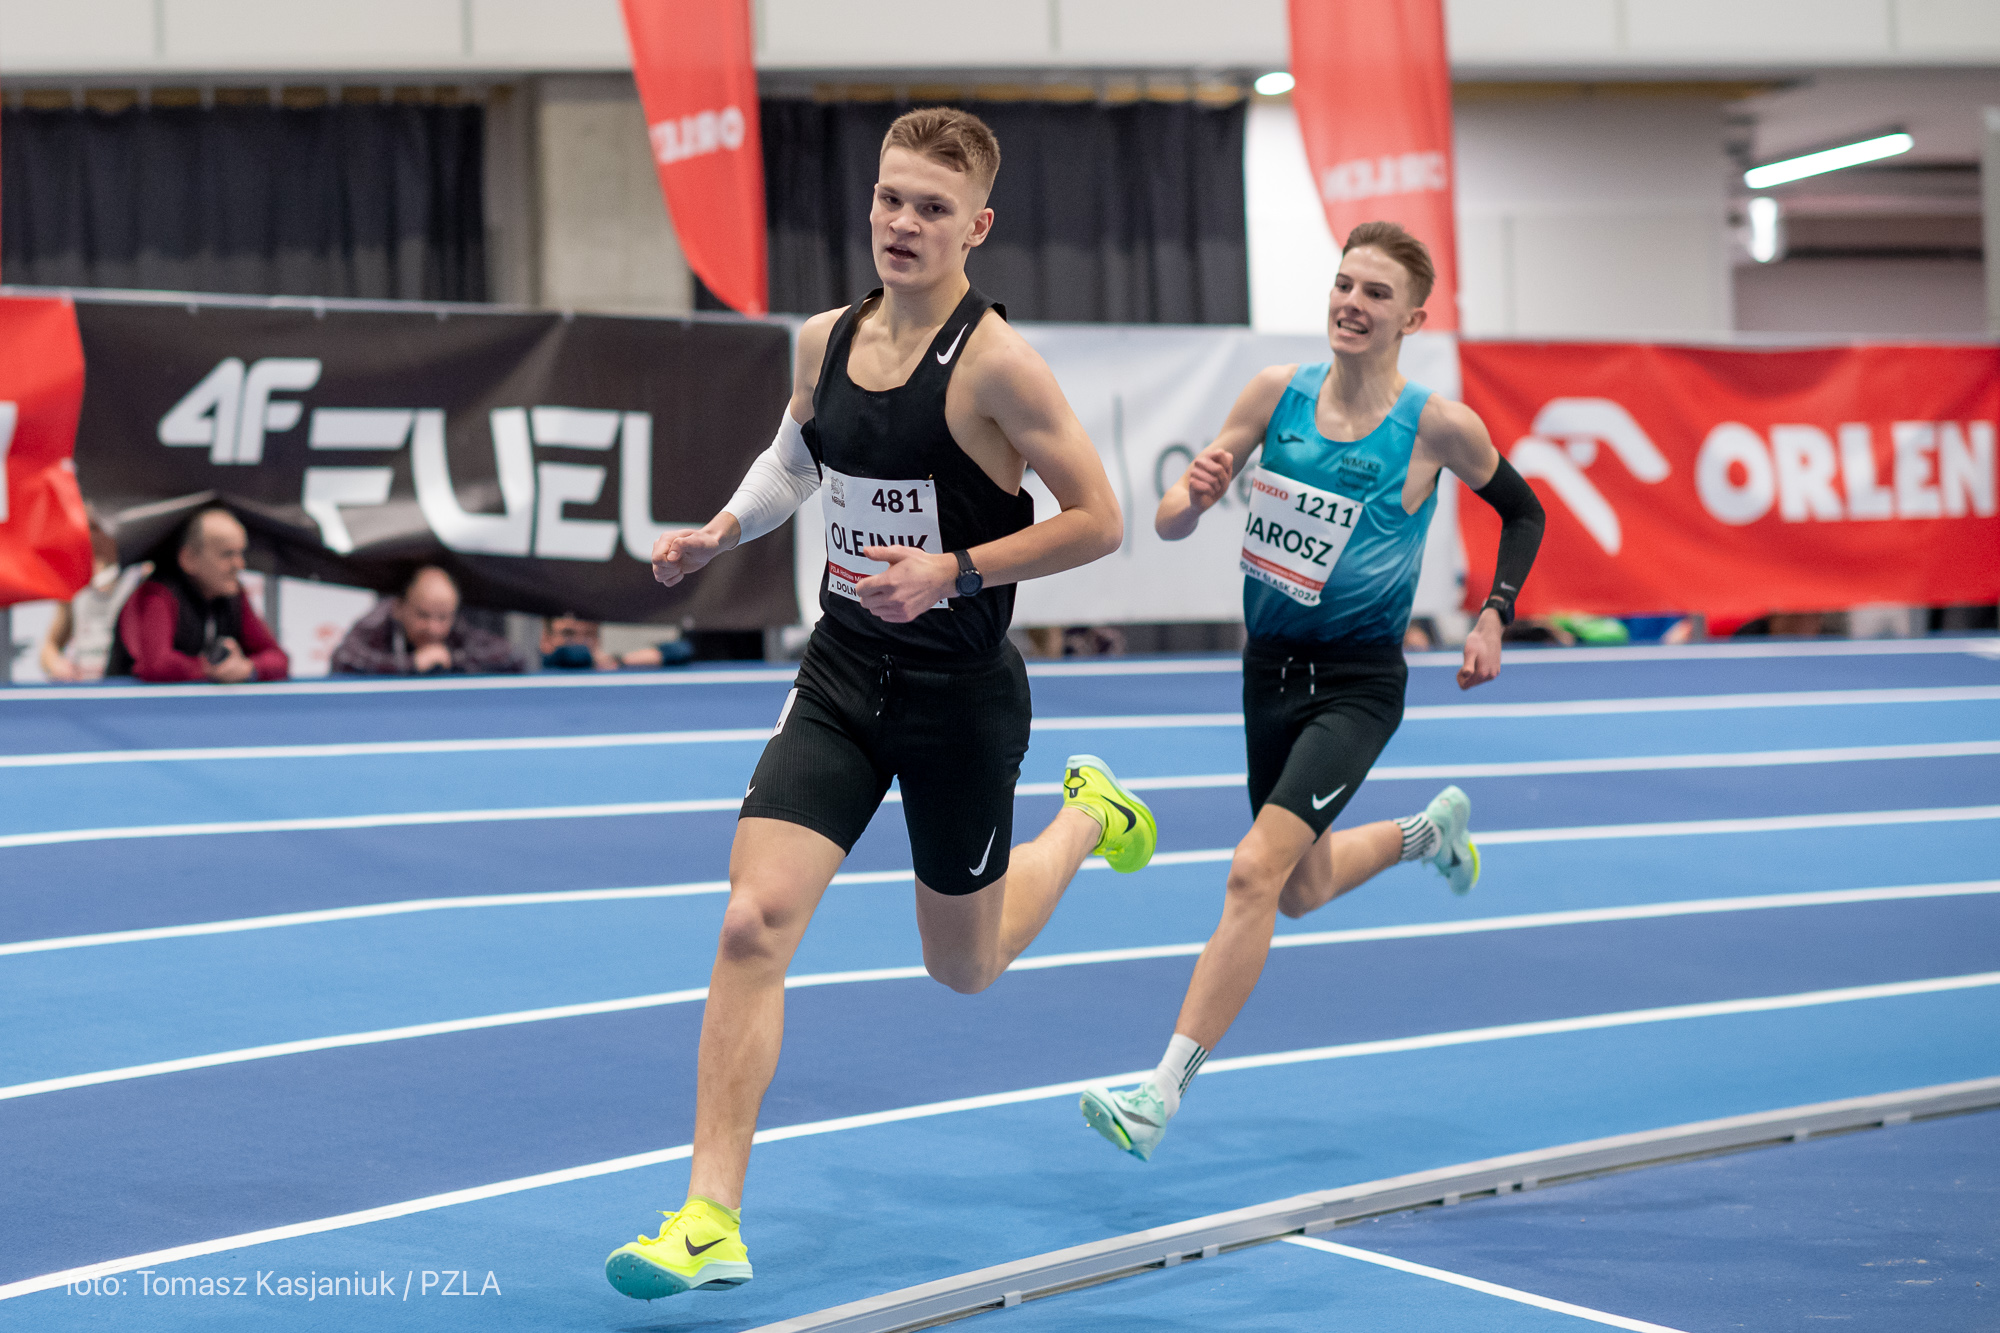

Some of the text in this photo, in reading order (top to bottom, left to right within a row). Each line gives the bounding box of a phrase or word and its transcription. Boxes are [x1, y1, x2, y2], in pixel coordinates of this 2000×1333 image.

[158, 357, 322, 466] 4F
[302, 405, 706, 563] FUEL
[1695, 419, 1996, 526] ORLEN
[871, 488, 923, 513] 481
[1295, 492, 1354, 529] 1211
[836, 580, 857, 597] DOLN
[1240, 560, 1261, 578] OLNY
[1292, 587, 1317, 602] 2024
